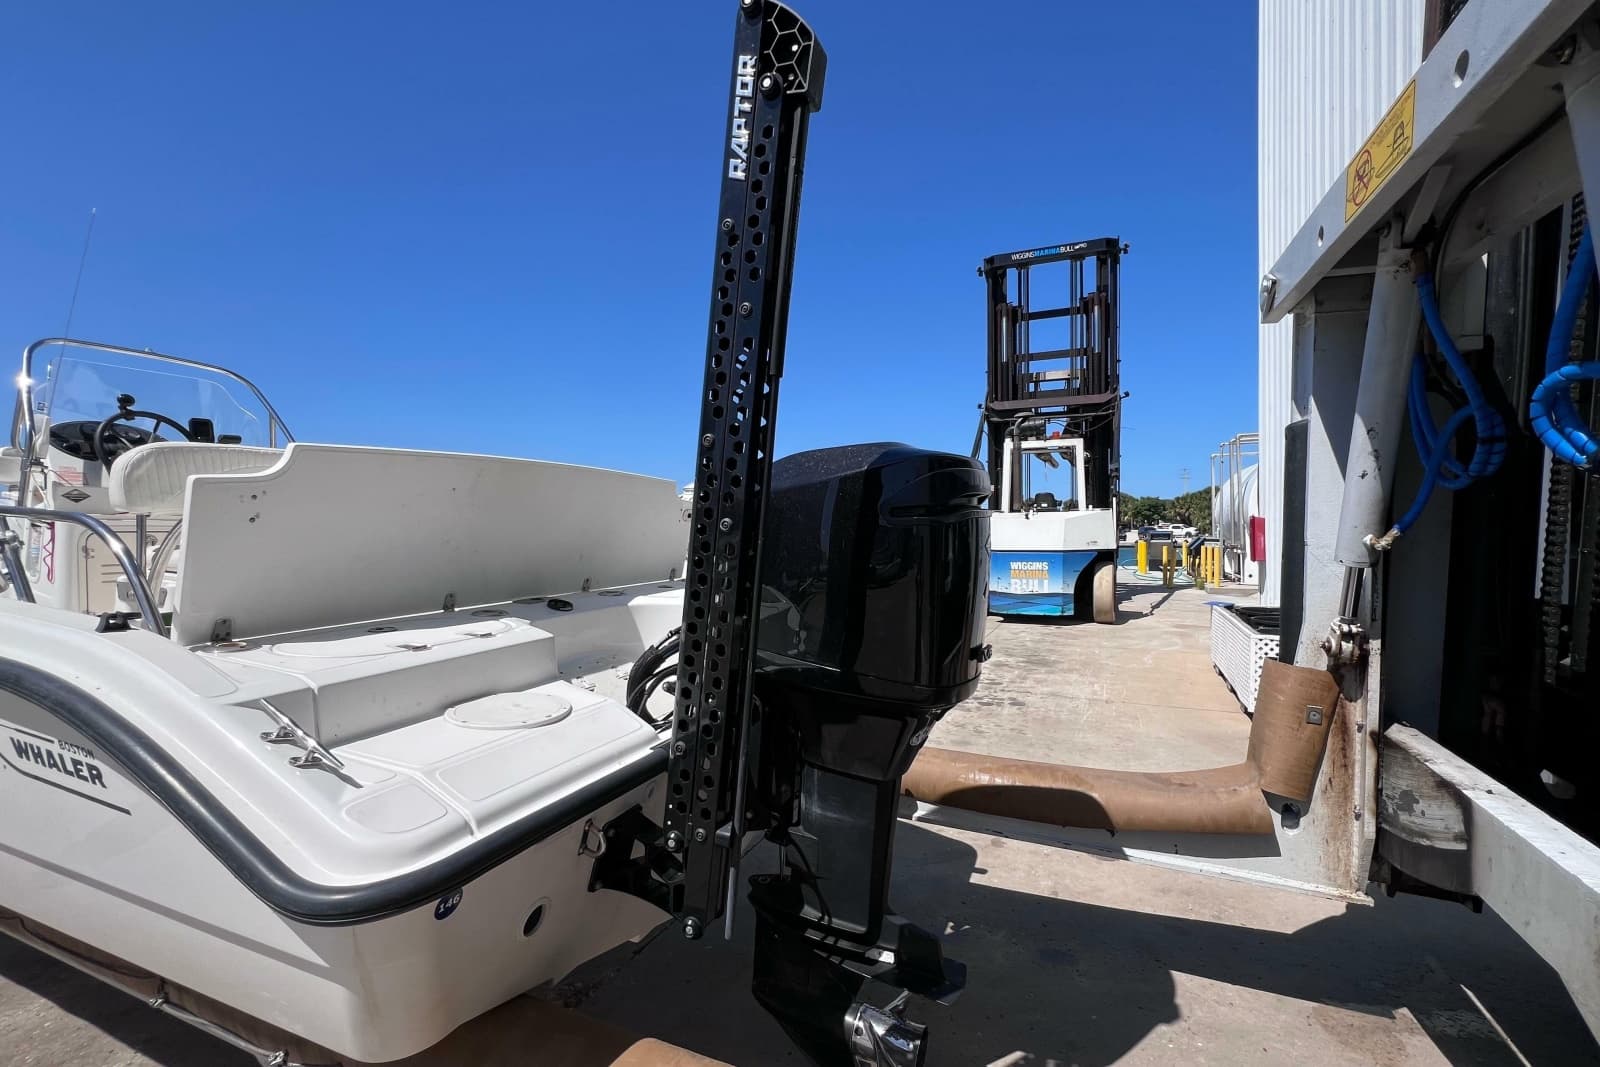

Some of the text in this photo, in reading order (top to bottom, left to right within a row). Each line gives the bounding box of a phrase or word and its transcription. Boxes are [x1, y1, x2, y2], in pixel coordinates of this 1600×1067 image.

[728, 55, 757, 180] RAPTOR
[1010, 561, 1049, 570] WIGGINS
[9, 736, 107, 789] WHALER
[58, 740, 95, 760] BOSTON
